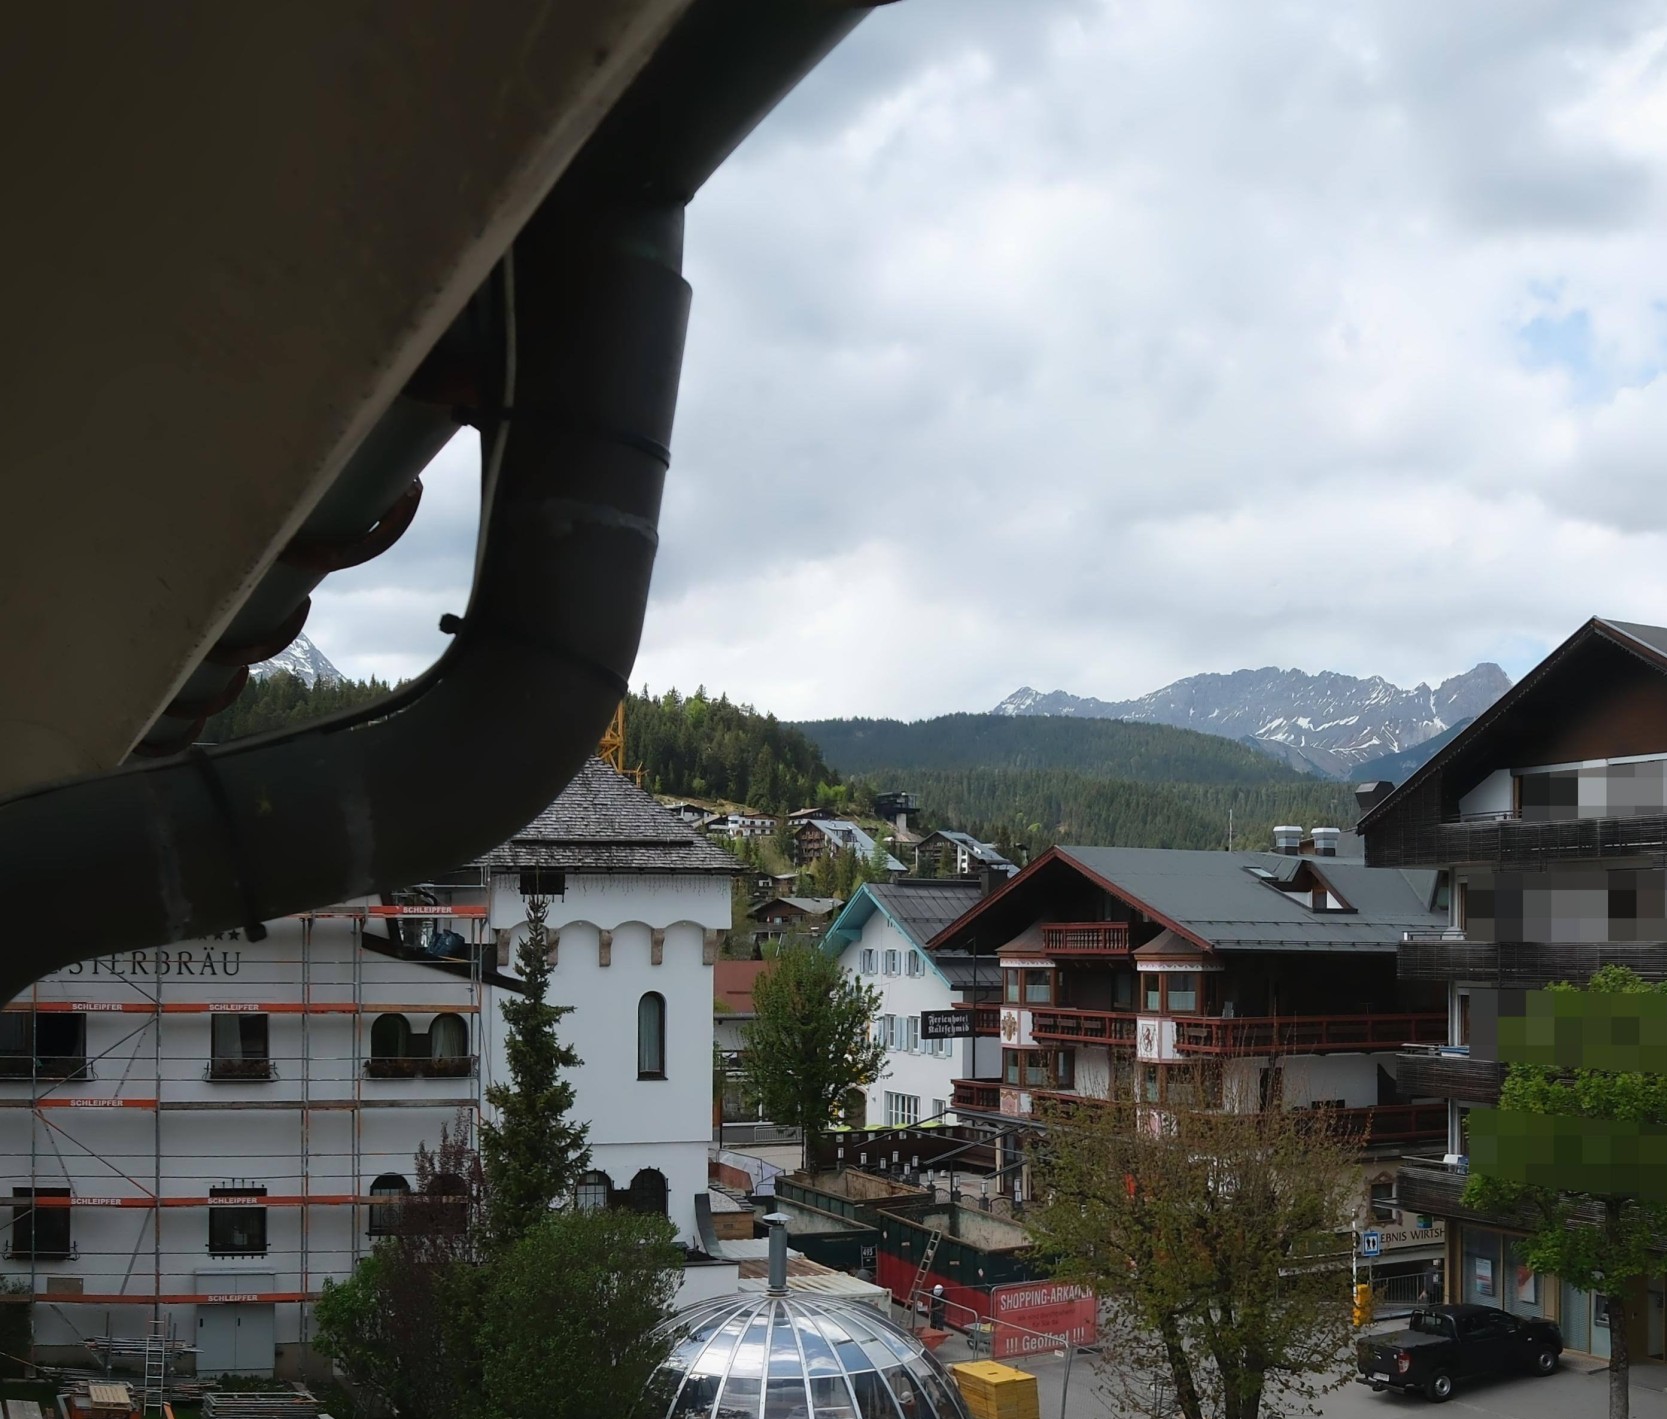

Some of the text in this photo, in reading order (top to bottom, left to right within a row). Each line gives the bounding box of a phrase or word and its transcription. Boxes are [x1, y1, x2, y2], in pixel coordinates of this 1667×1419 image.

[403, 905, 453, 914] SCHLEIPFER
[50, 947, 241, 976] STERBRÄU
[72, 1003, 123, 1011] SCHLEIPFER
[71, 1198, 122, 1206] SCHLEIPFER
[207, 1294, 258, 1302] SCHLEIPFER
